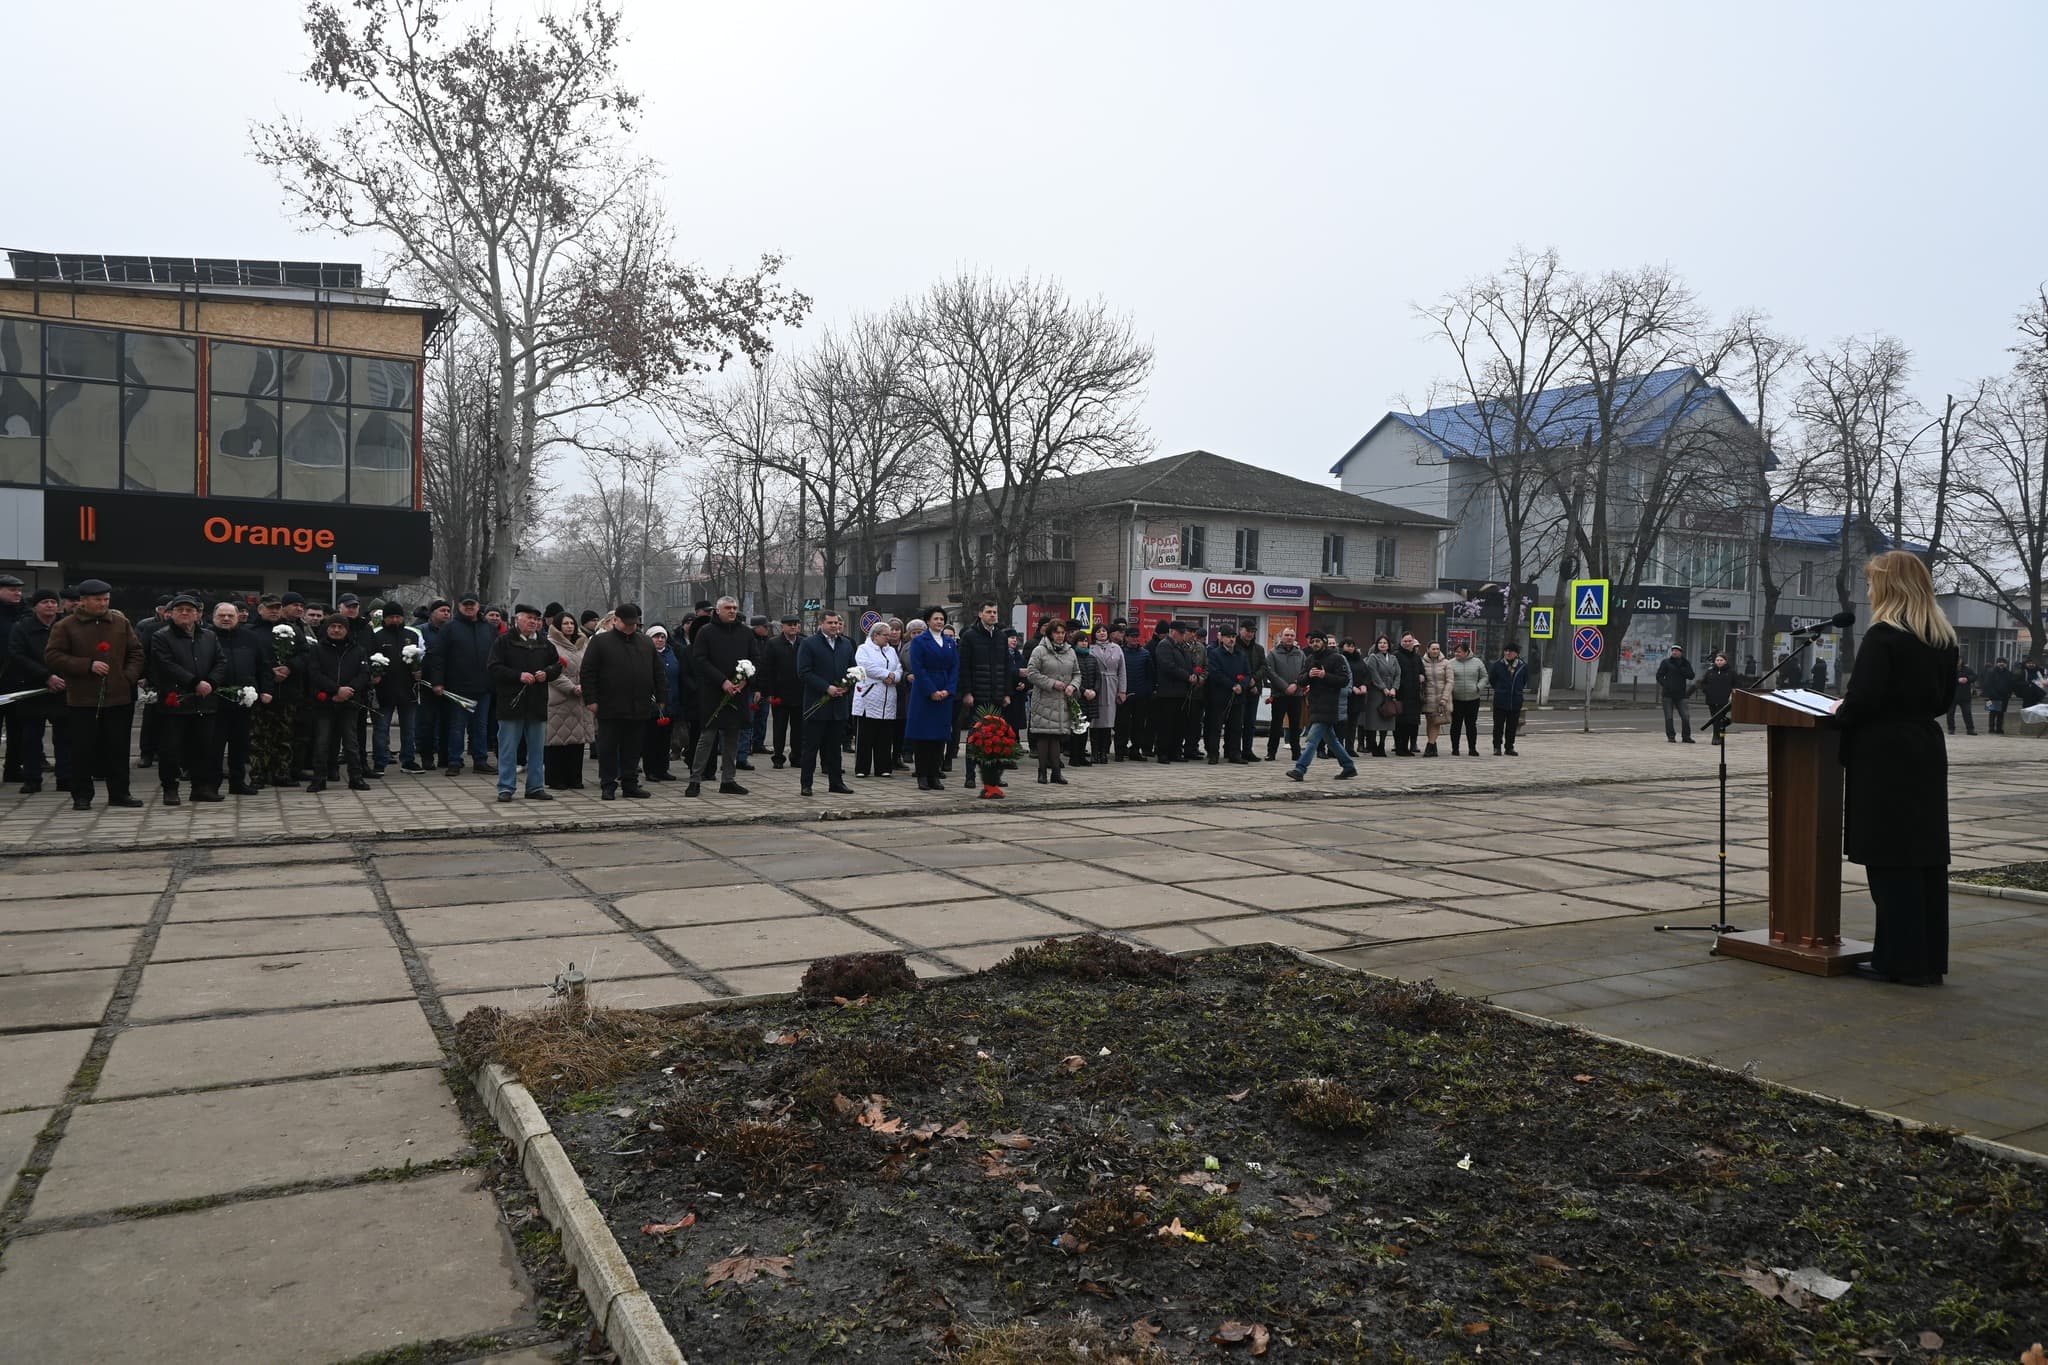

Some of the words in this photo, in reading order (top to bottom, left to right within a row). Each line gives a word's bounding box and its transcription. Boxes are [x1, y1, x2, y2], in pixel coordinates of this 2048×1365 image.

[204, 516, 335, 553] Orange
[1160, 582, 1187, 590] LOMBARD
[1209, 582, 1252, 595] BLAGO
